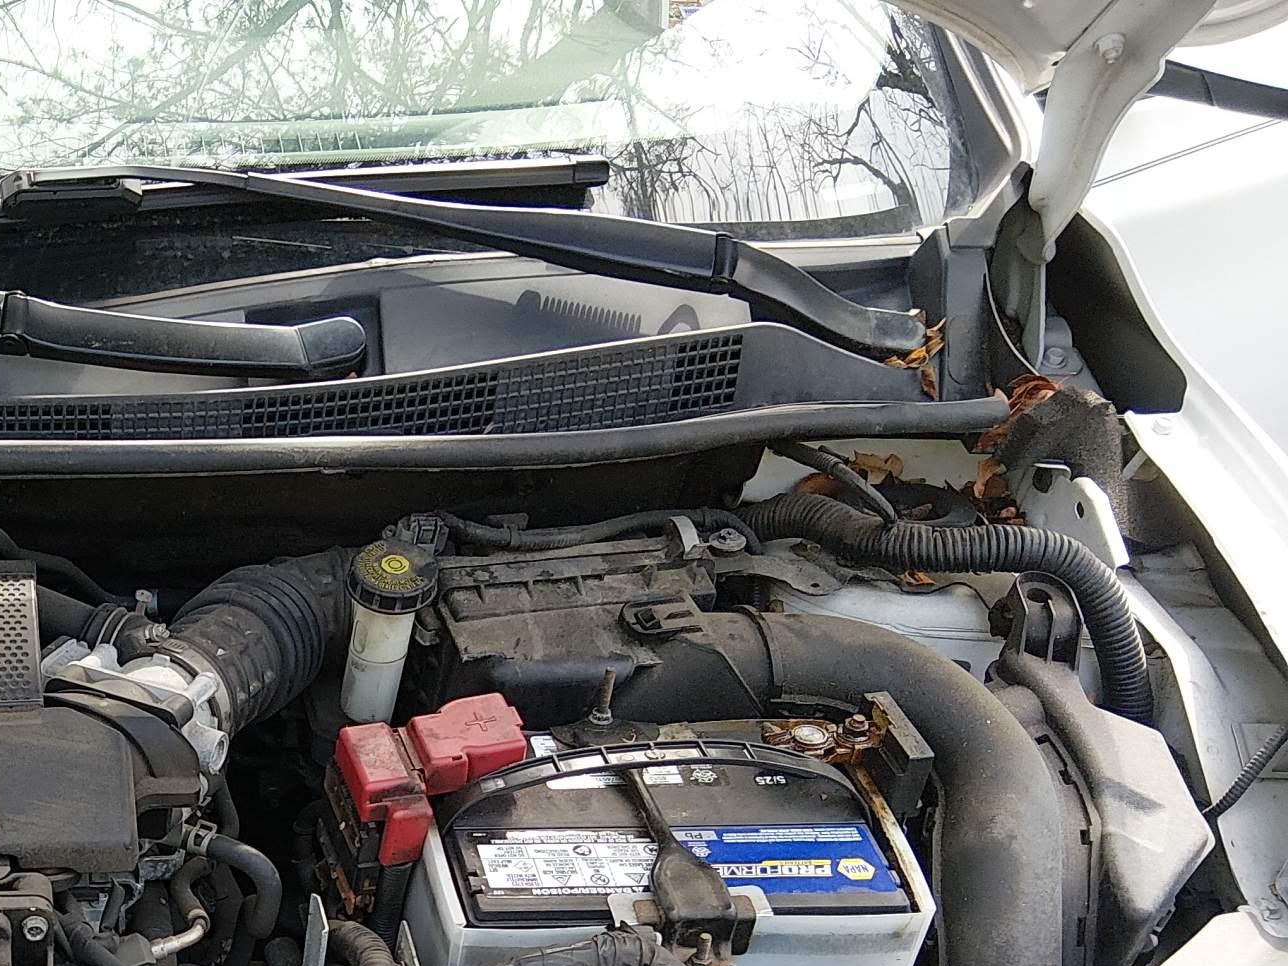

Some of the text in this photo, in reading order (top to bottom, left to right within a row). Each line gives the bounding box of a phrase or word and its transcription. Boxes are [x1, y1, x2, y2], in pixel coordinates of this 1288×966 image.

[754, 775, 787, 785] 5/25
[685, 831, 703, 839] Pb
[844, 863, 869, 874] NAPA
[532, 888, 630, 896] DANGER/POISON
